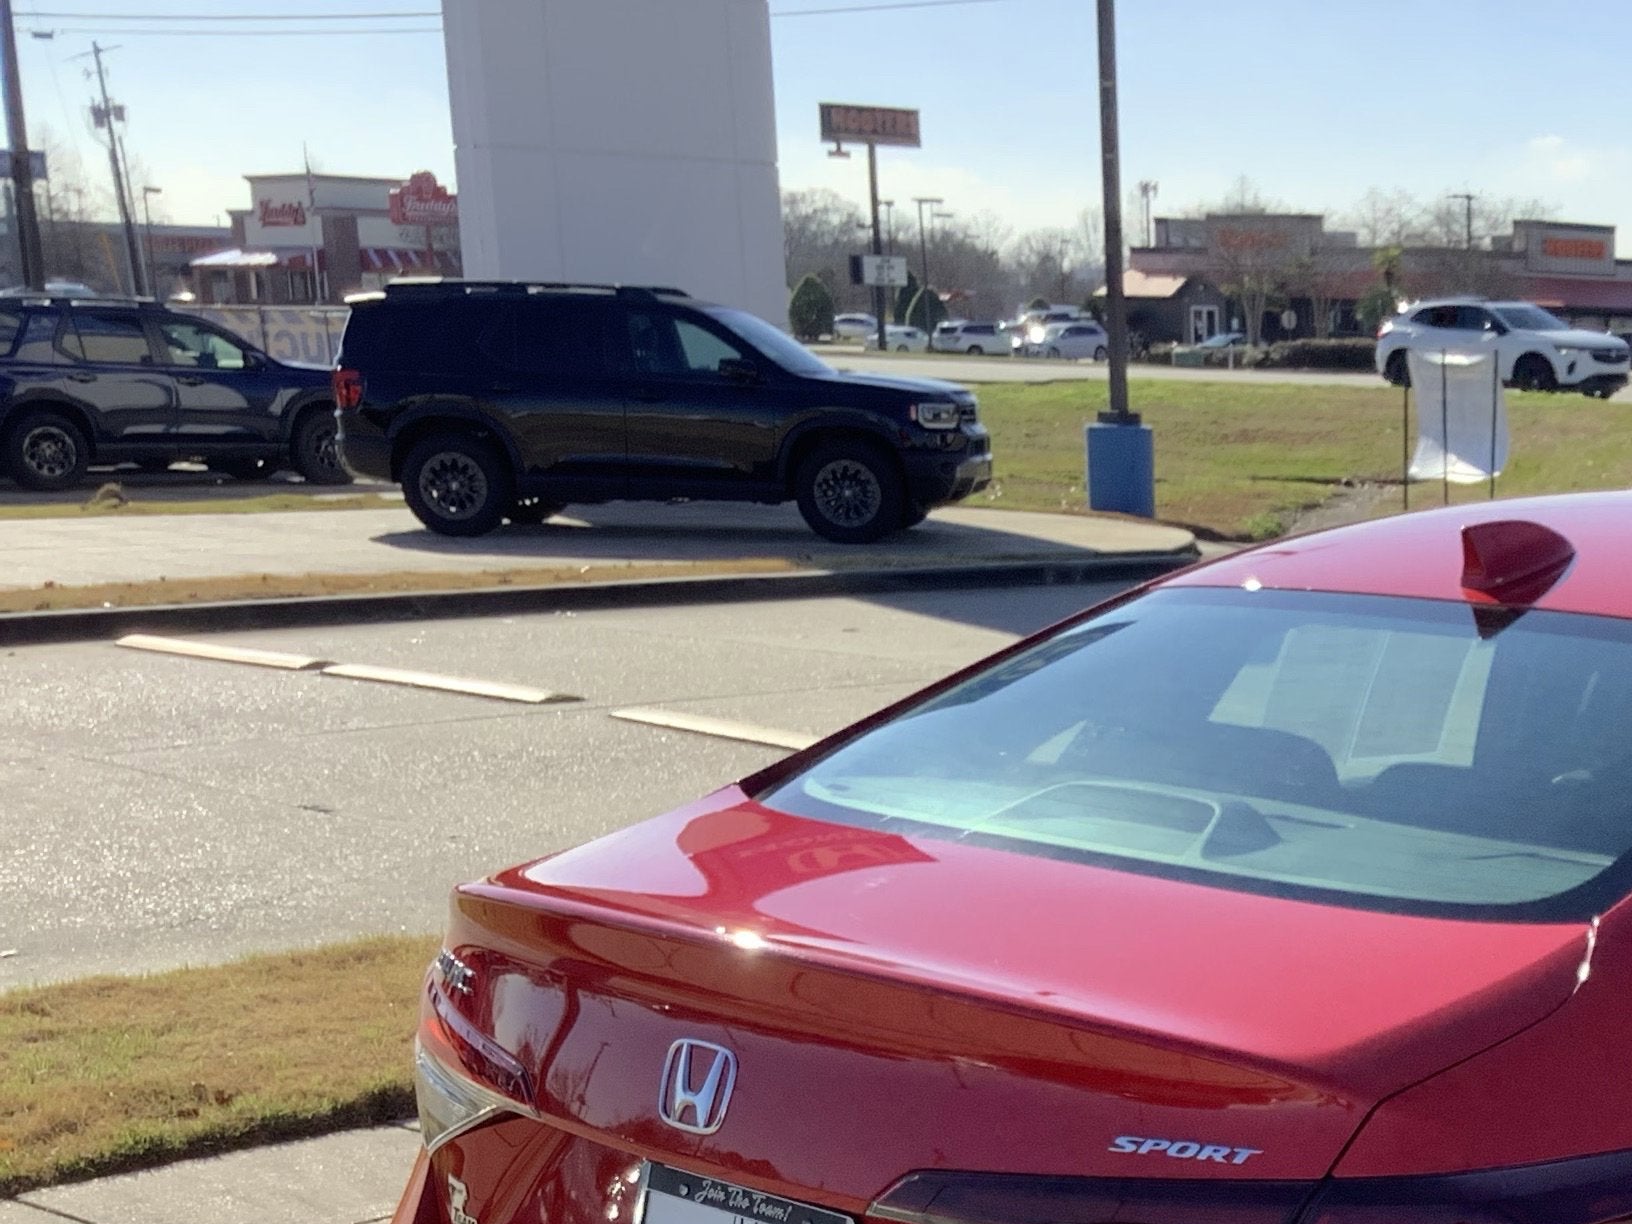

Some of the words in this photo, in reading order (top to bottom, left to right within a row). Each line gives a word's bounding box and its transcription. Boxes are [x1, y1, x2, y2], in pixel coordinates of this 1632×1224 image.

[1108, 1135, 1264, 1165] SPORT
[695, 1179, 726, 1202] Join
[728, 1187, 751, 1209] The
[752, 1194, 792, 1222] Team!
